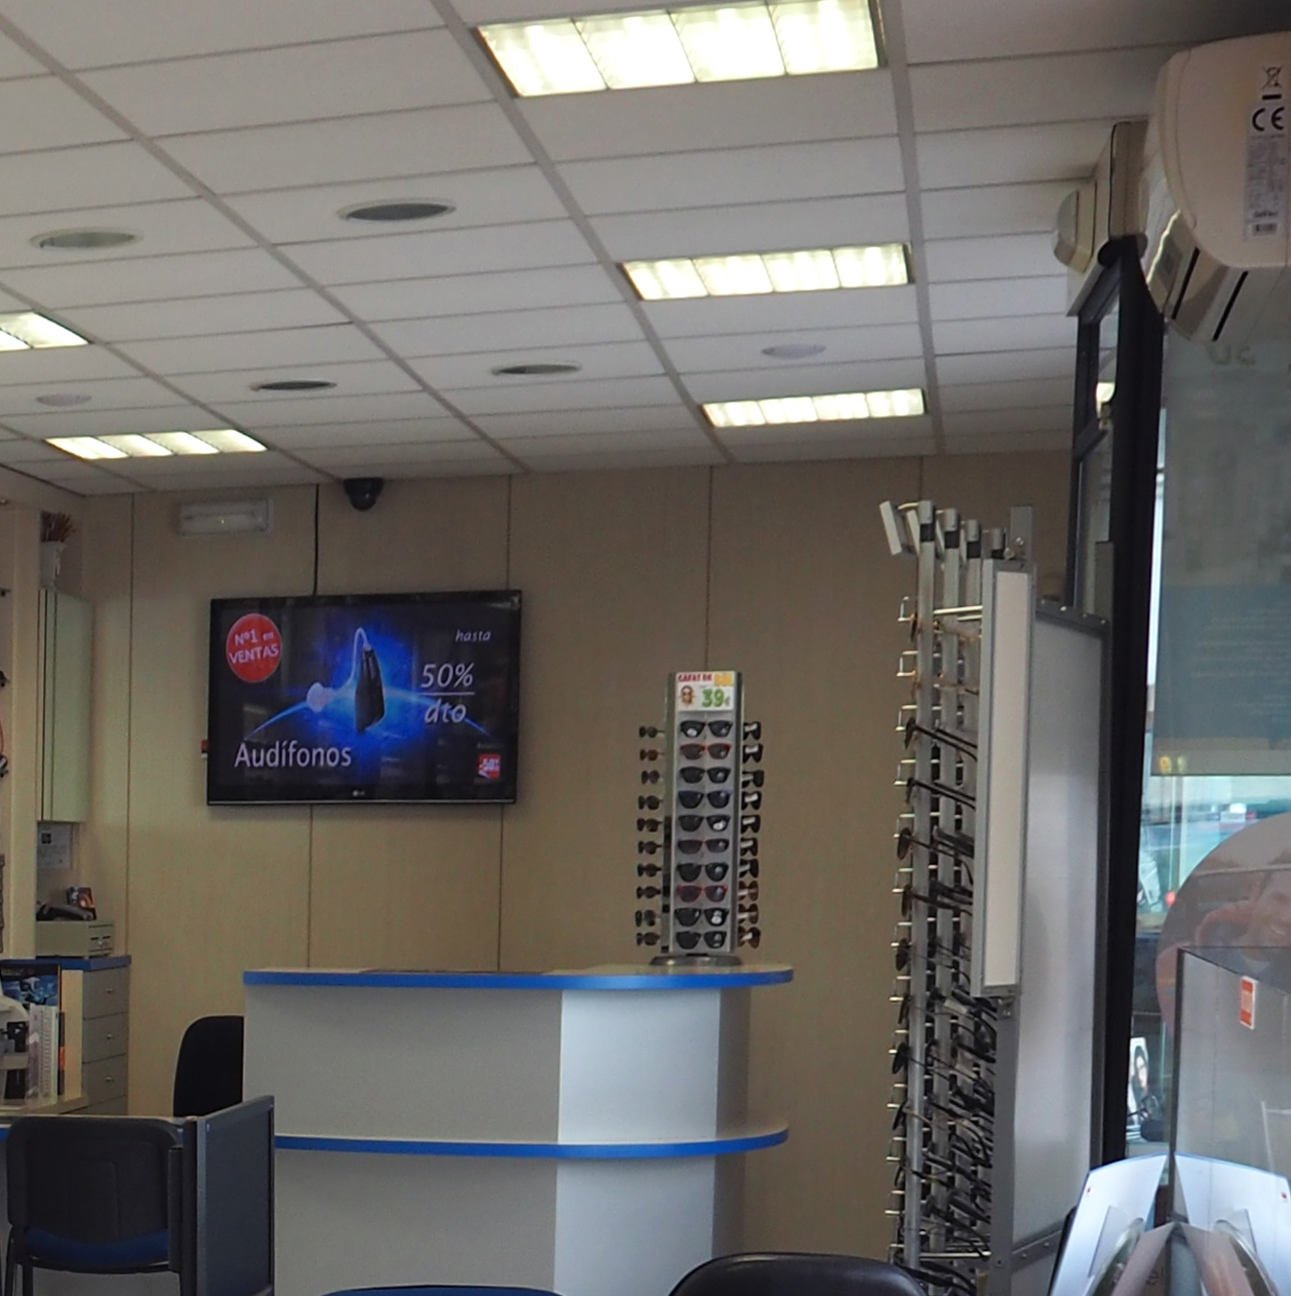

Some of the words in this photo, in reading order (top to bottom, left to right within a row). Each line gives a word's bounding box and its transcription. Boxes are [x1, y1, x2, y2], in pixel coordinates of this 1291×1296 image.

[1252, 106, 1285, 131] CE
[455, 629, 491, 643] hasta
[229, 643, 279, 664] VENTAS
[421, 663, 475, 688] 50%
[702, 688, 725, 707] 39
[424, 698, 467, 724] dto
[234, 740, 352, 768] Audífonos
